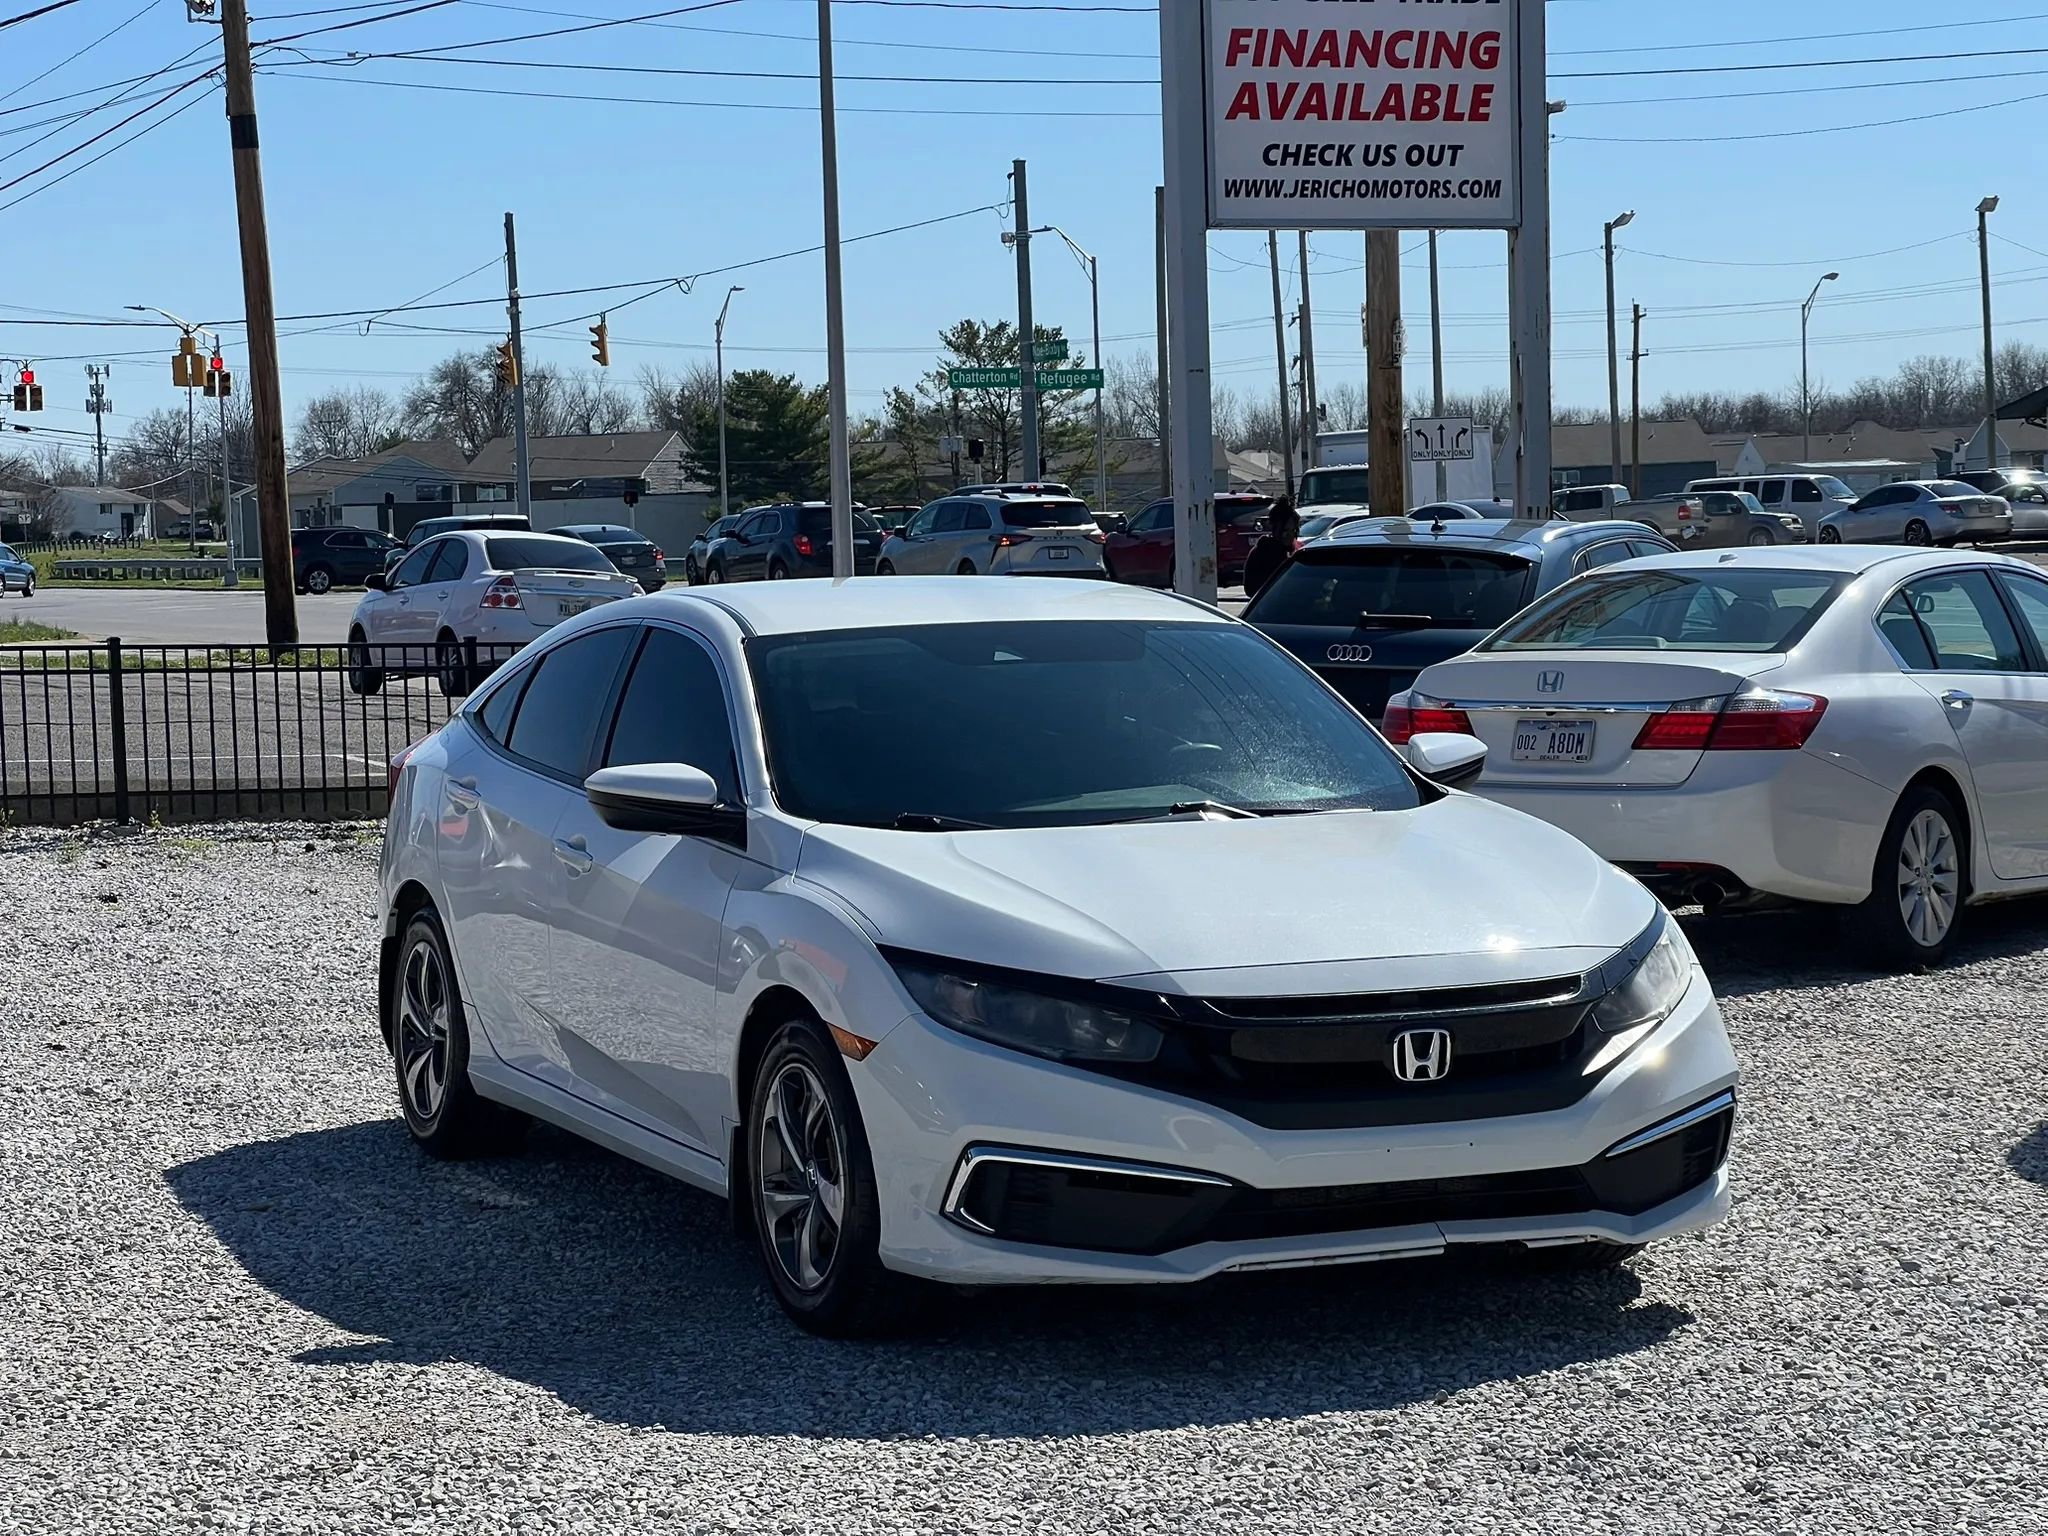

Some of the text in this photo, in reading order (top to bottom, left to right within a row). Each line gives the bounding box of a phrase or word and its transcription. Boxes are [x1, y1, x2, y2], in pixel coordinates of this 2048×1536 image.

[1224, 28, 1501, 70] FINANCING
[1224, 81, 1495, 122] AVAILABLE
[1262, 143, 1464, 167] CHECK US OUT
[1224, 178, 1502, 199] WWW.JERICHOMOTORS.COM
[952, 371, 1018, 383] Chatterton Rd
[1040, 372, 1087, 386] Refugee
[1433, 450, 1452, 458] ONLY
[1454, 449, 1472, 457] ONLY
[1517, 734, 1537, 750] 002
